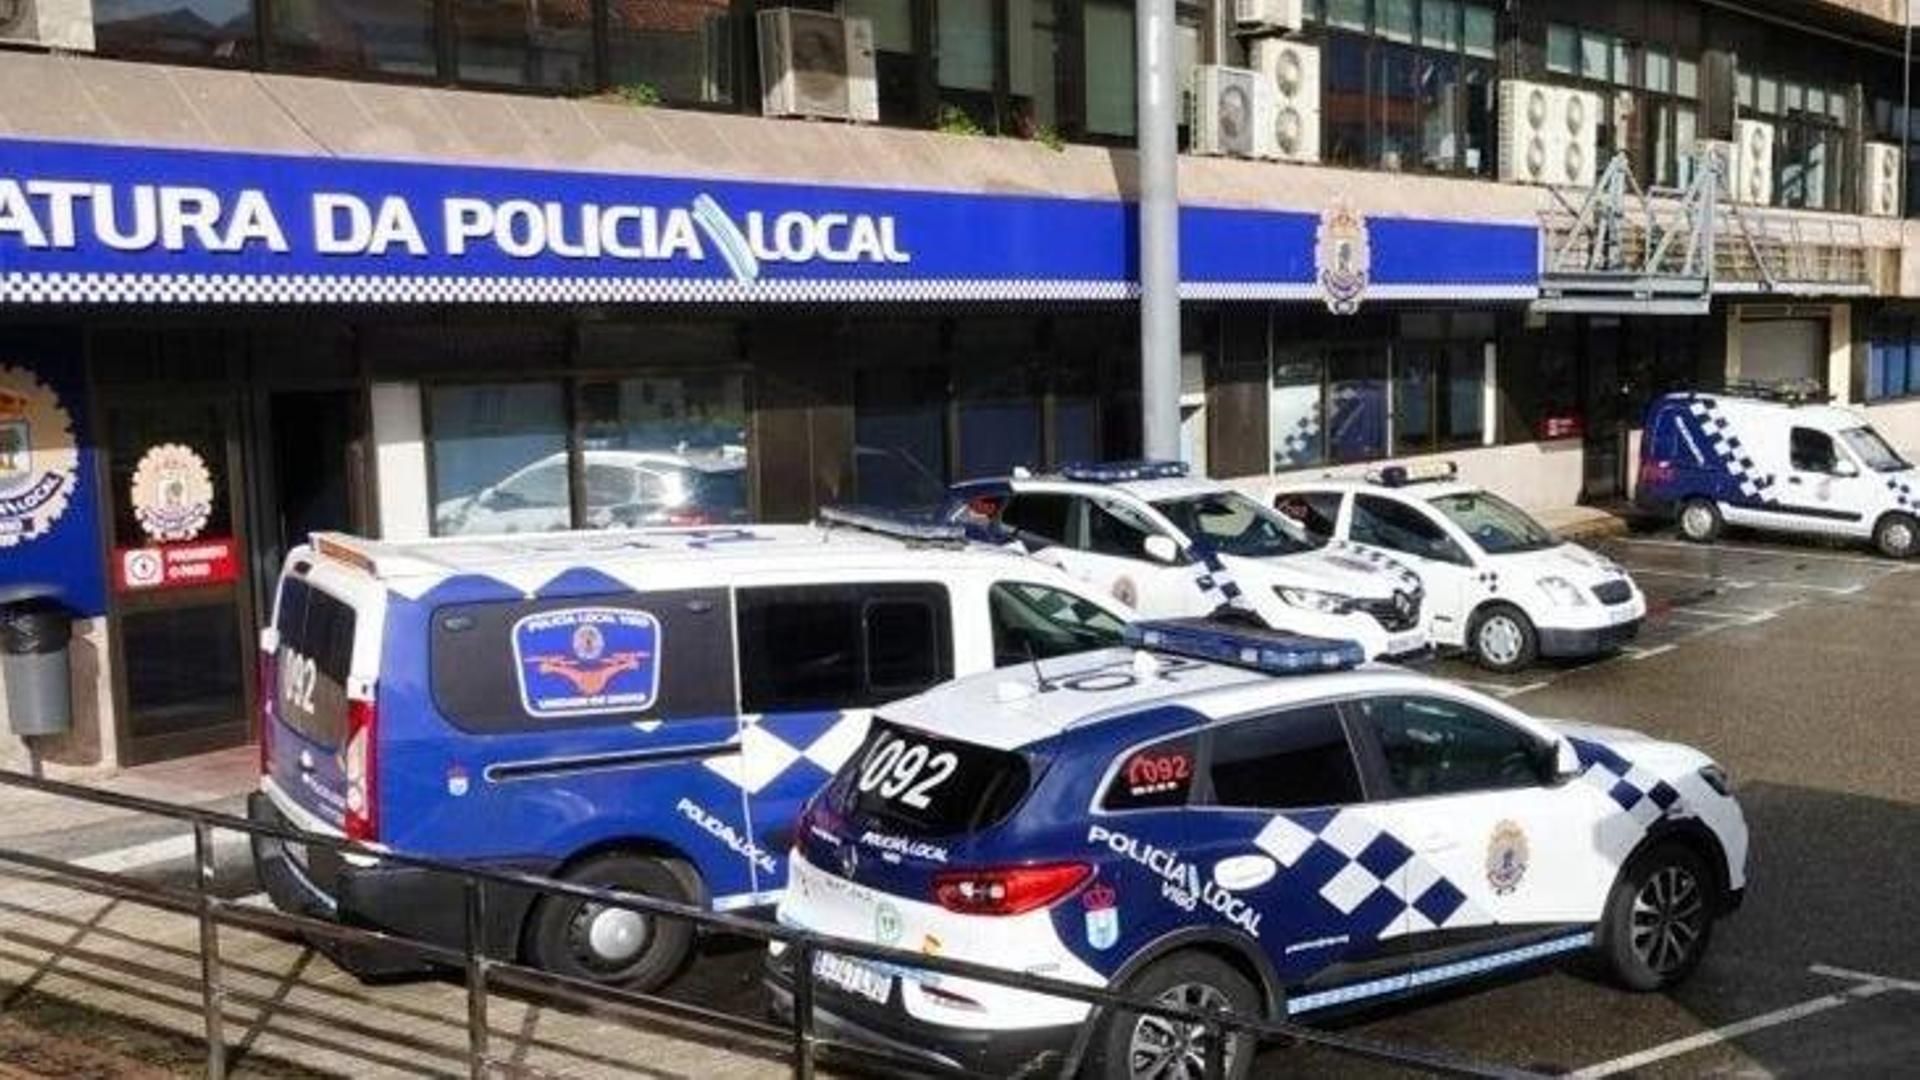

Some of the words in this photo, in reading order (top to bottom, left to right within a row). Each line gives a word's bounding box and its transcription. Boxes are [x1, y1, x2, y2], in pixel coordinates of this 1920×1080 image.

[312, 193, 428, 257] DA
[444, 198, 704, 260] POLICIA
[747, 211, 911, 263] LOCAL
[858, 739, 959, 809] 092
[1143, 755, 1190, 783] 092
[1203, 880, 1262, 938] LOCAL
